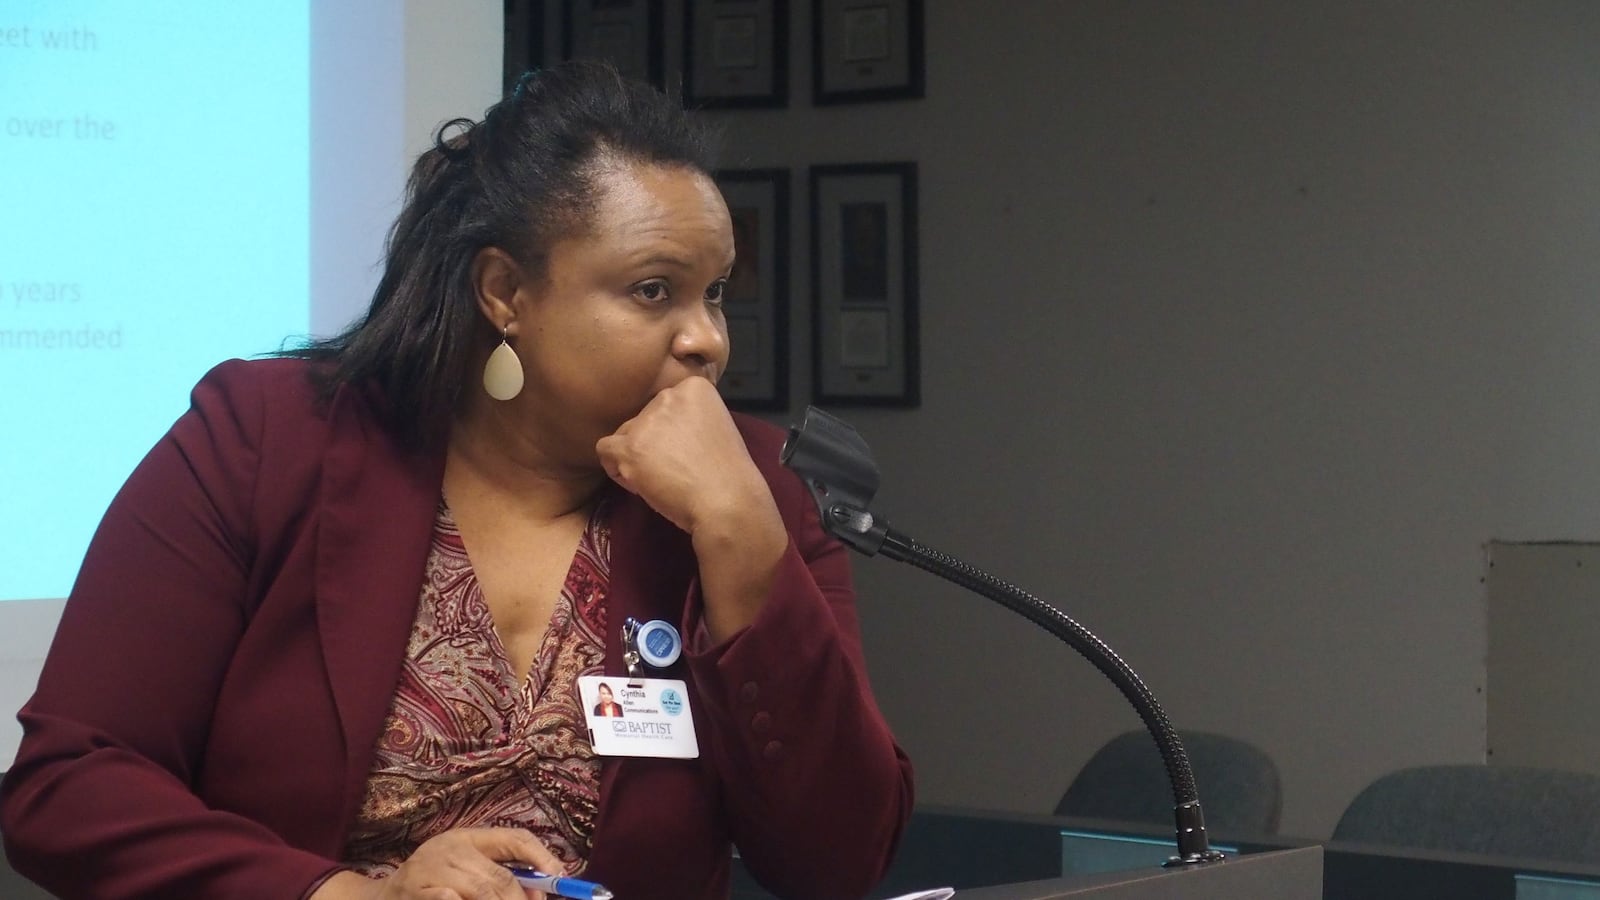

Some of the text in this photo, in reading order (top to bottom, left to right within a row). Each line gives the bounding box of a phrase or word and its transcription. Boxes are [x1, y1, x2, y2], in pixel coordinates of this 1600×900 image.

[41, 24, 98, 51] with
[6, 111, 117, 141] over the
[11, 281, 81, 309] years
[620, 689, 646, 699] Cynthia
[628, 721, 672, 734] BAPTIST
